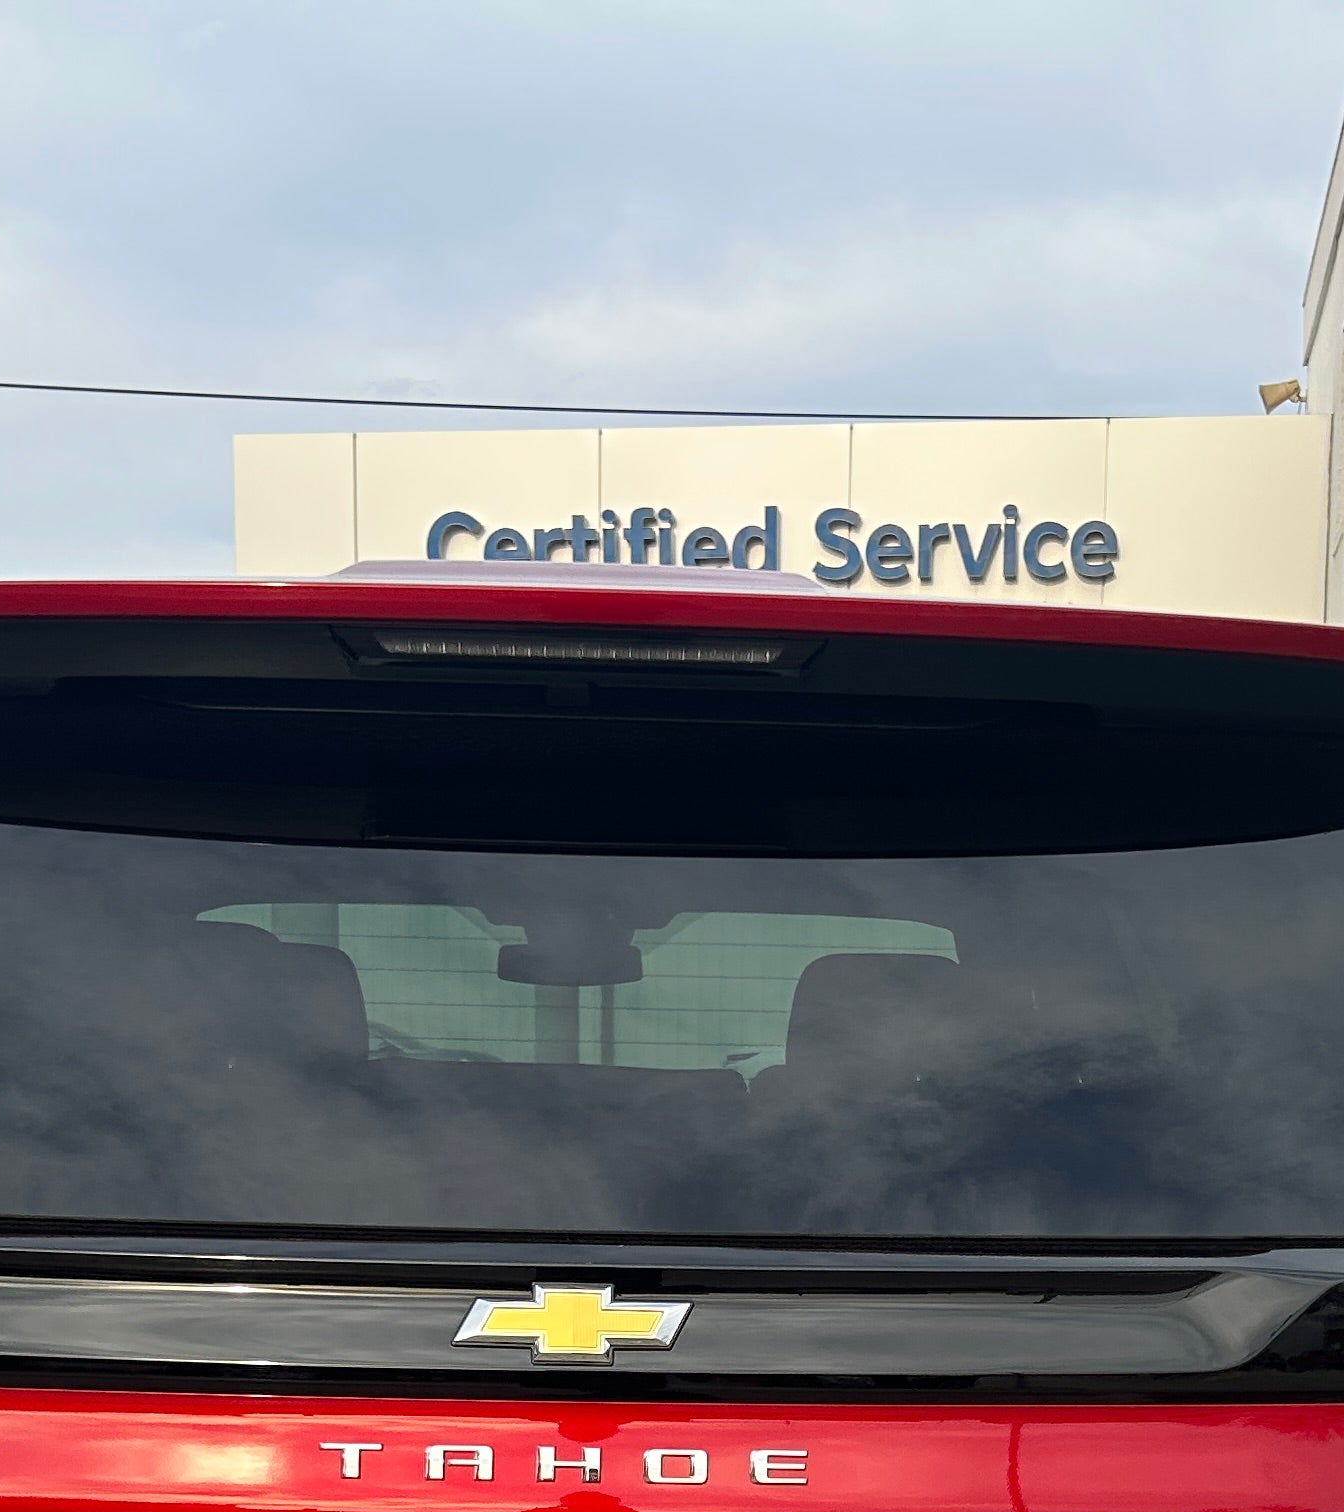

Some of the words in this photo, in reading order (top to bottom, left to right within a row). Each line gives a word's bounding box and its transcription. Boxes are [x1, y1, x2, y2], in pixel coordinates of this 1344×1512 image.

[426, 505, 781, 571] Certified
[812, 504, 1119, 583] Service
[318, 1441, 809, 1485] TAHOE
